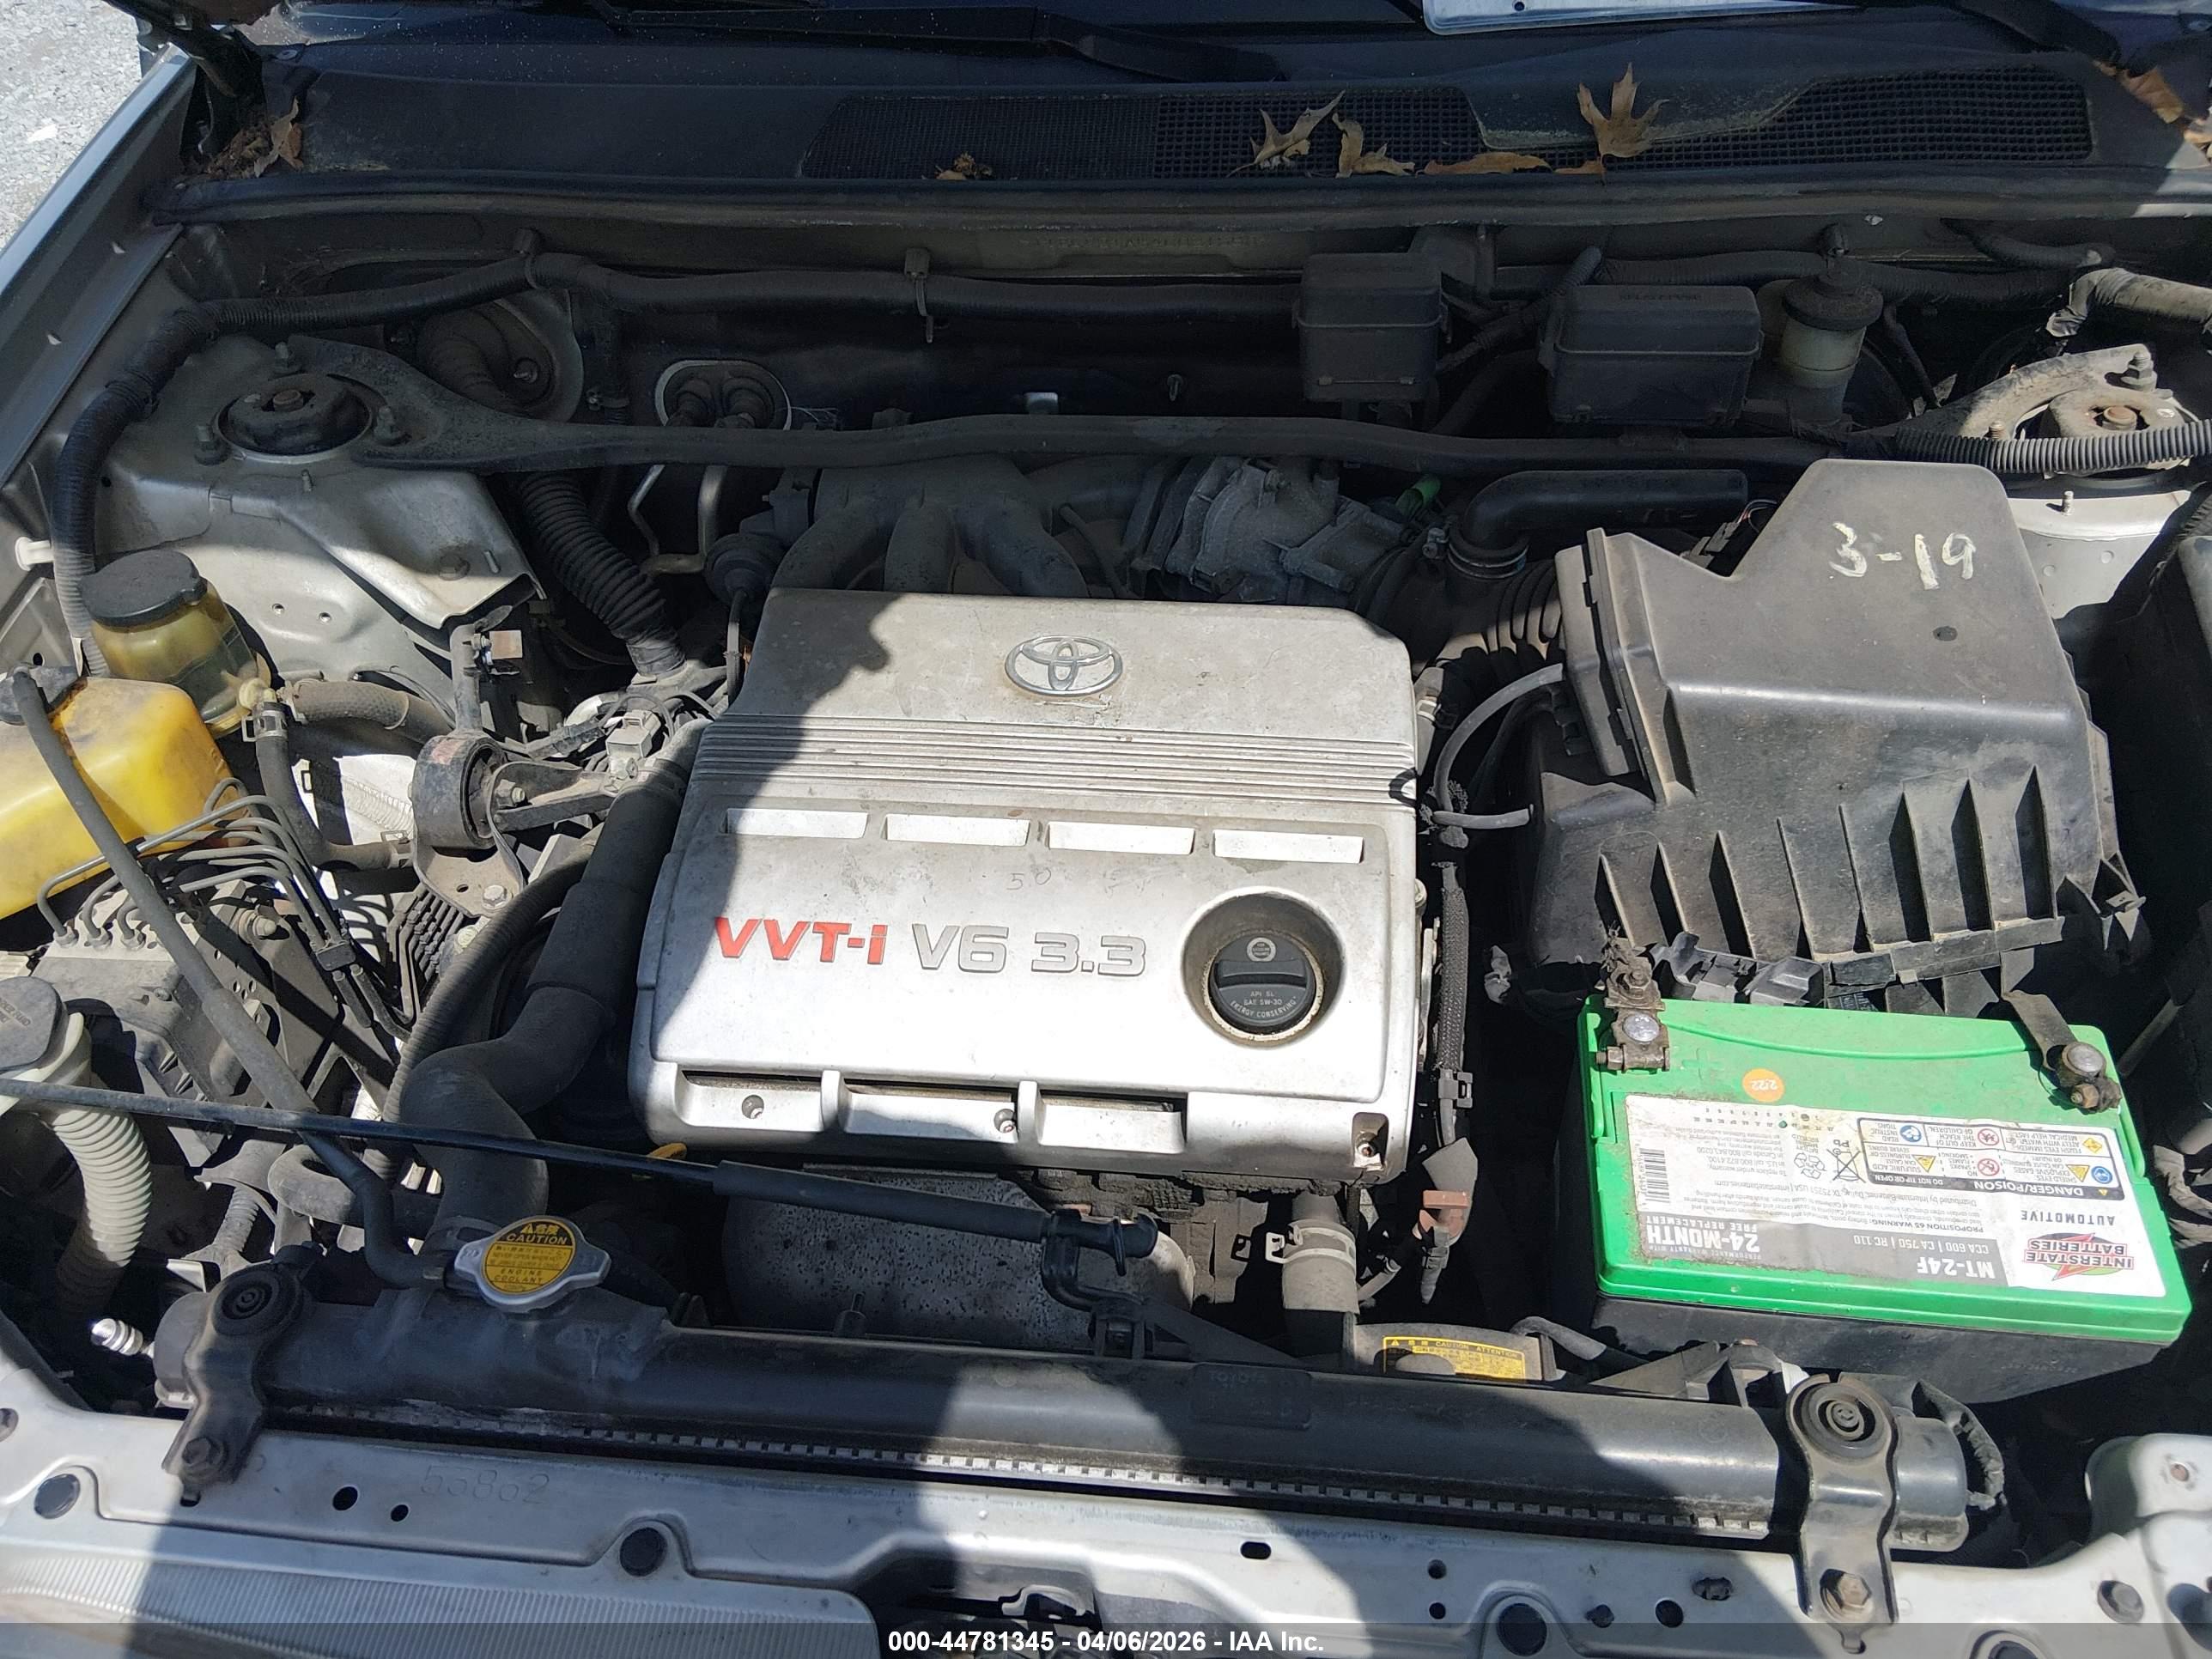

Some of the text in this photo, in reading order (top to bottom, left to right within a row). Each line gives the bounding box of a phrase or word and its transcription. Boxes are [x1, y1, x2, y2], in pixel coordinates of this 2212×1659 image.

[1829, 521, 1977, 591] 3-19
[718, 916, 1147, 976] VVT-i V6 3.3
[1230, 1000, 1255, 1016] ENERGY
[1833, 1139, 1850, 1148] Pb
[1973, 1181, 2084, 1196] DANGER/POISON
[1869, 1218, 1911, 1228] WARNING:
[2021, 1210, 2115, 1226] AUTOMOTIVE
[1646, 1215, 1757, 1233] FREE REPLACEMENT
[1926, 1223, 1984, 1233] PROPOSITION
[507, 1233, 568, 1245] CAUTION
[1646, 1224, 1759, 1253] 24-MONTH
[1853, 1235, 1871, 1245] 110
[1874, 1237, 1888, 1247] RC
[1899, 1238, 1919, 1249] 750
[1921, 1240, 1935, 1250] CA
[1945, 1242, 1966, 1253] 600
[1967, 1243, 1990, 1254] CCA
[2030, 1240, 2124, 1255] BATTERIES
[2026, 1252, 2132, 1268] INTERSTATE
[501, 1267, 543, 1276] ENGINE
[1917, 1256, 1996, 1279] MT-24F
[494, 1274, 543, 1283] COOLANT
